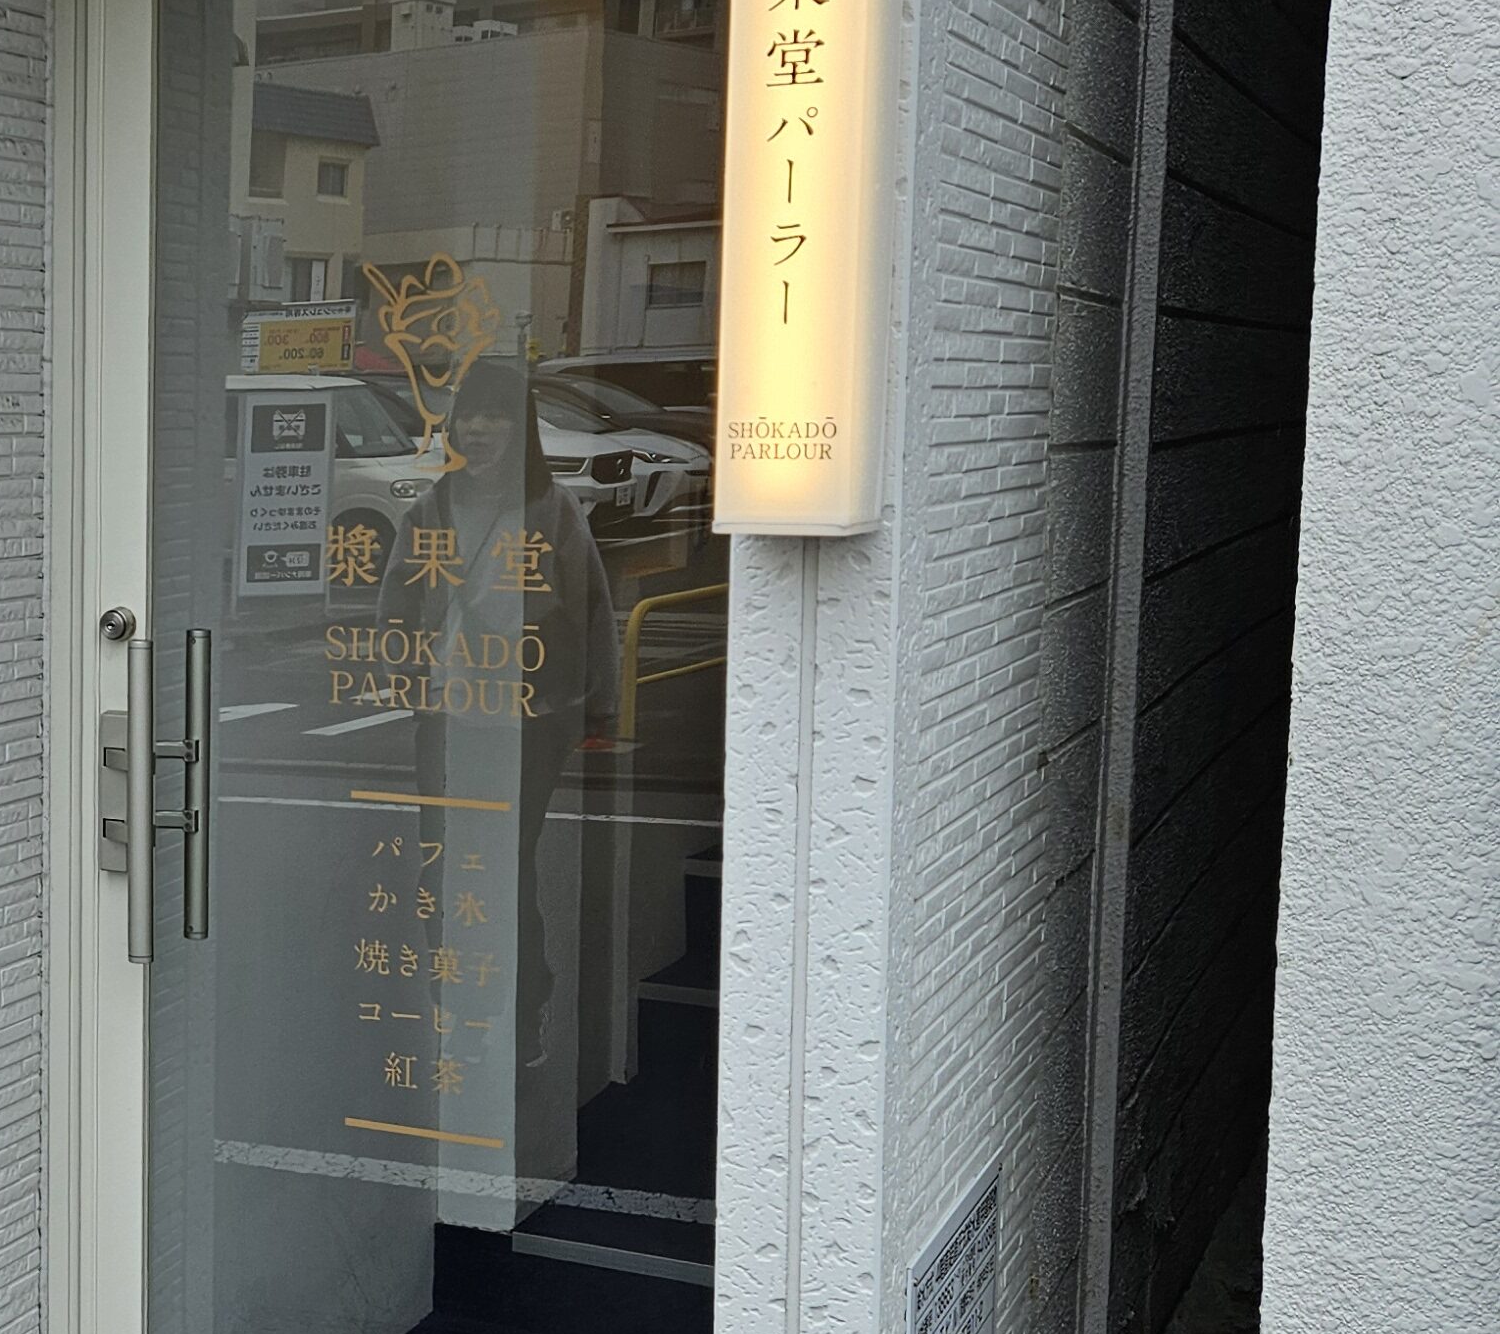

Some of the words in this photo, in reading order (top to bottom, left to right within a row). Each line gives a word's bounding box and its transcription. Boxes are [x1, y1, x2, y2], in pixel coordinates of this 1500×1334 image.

[727, 416, 838, 439] SHŌKADŌ
[729, 443, 833, 460] PARLOUR
[324, 618, 546, 672] SHŌKADŌ
[328, 670, 538, 718] PARLOUR
[372, 836, 485, 872] パフェ
[367, 882, 489, 927] かき氷
[353, 936, 498, 988] 焼き菓子
[383, 1051, 468, 1095] 紅茶
